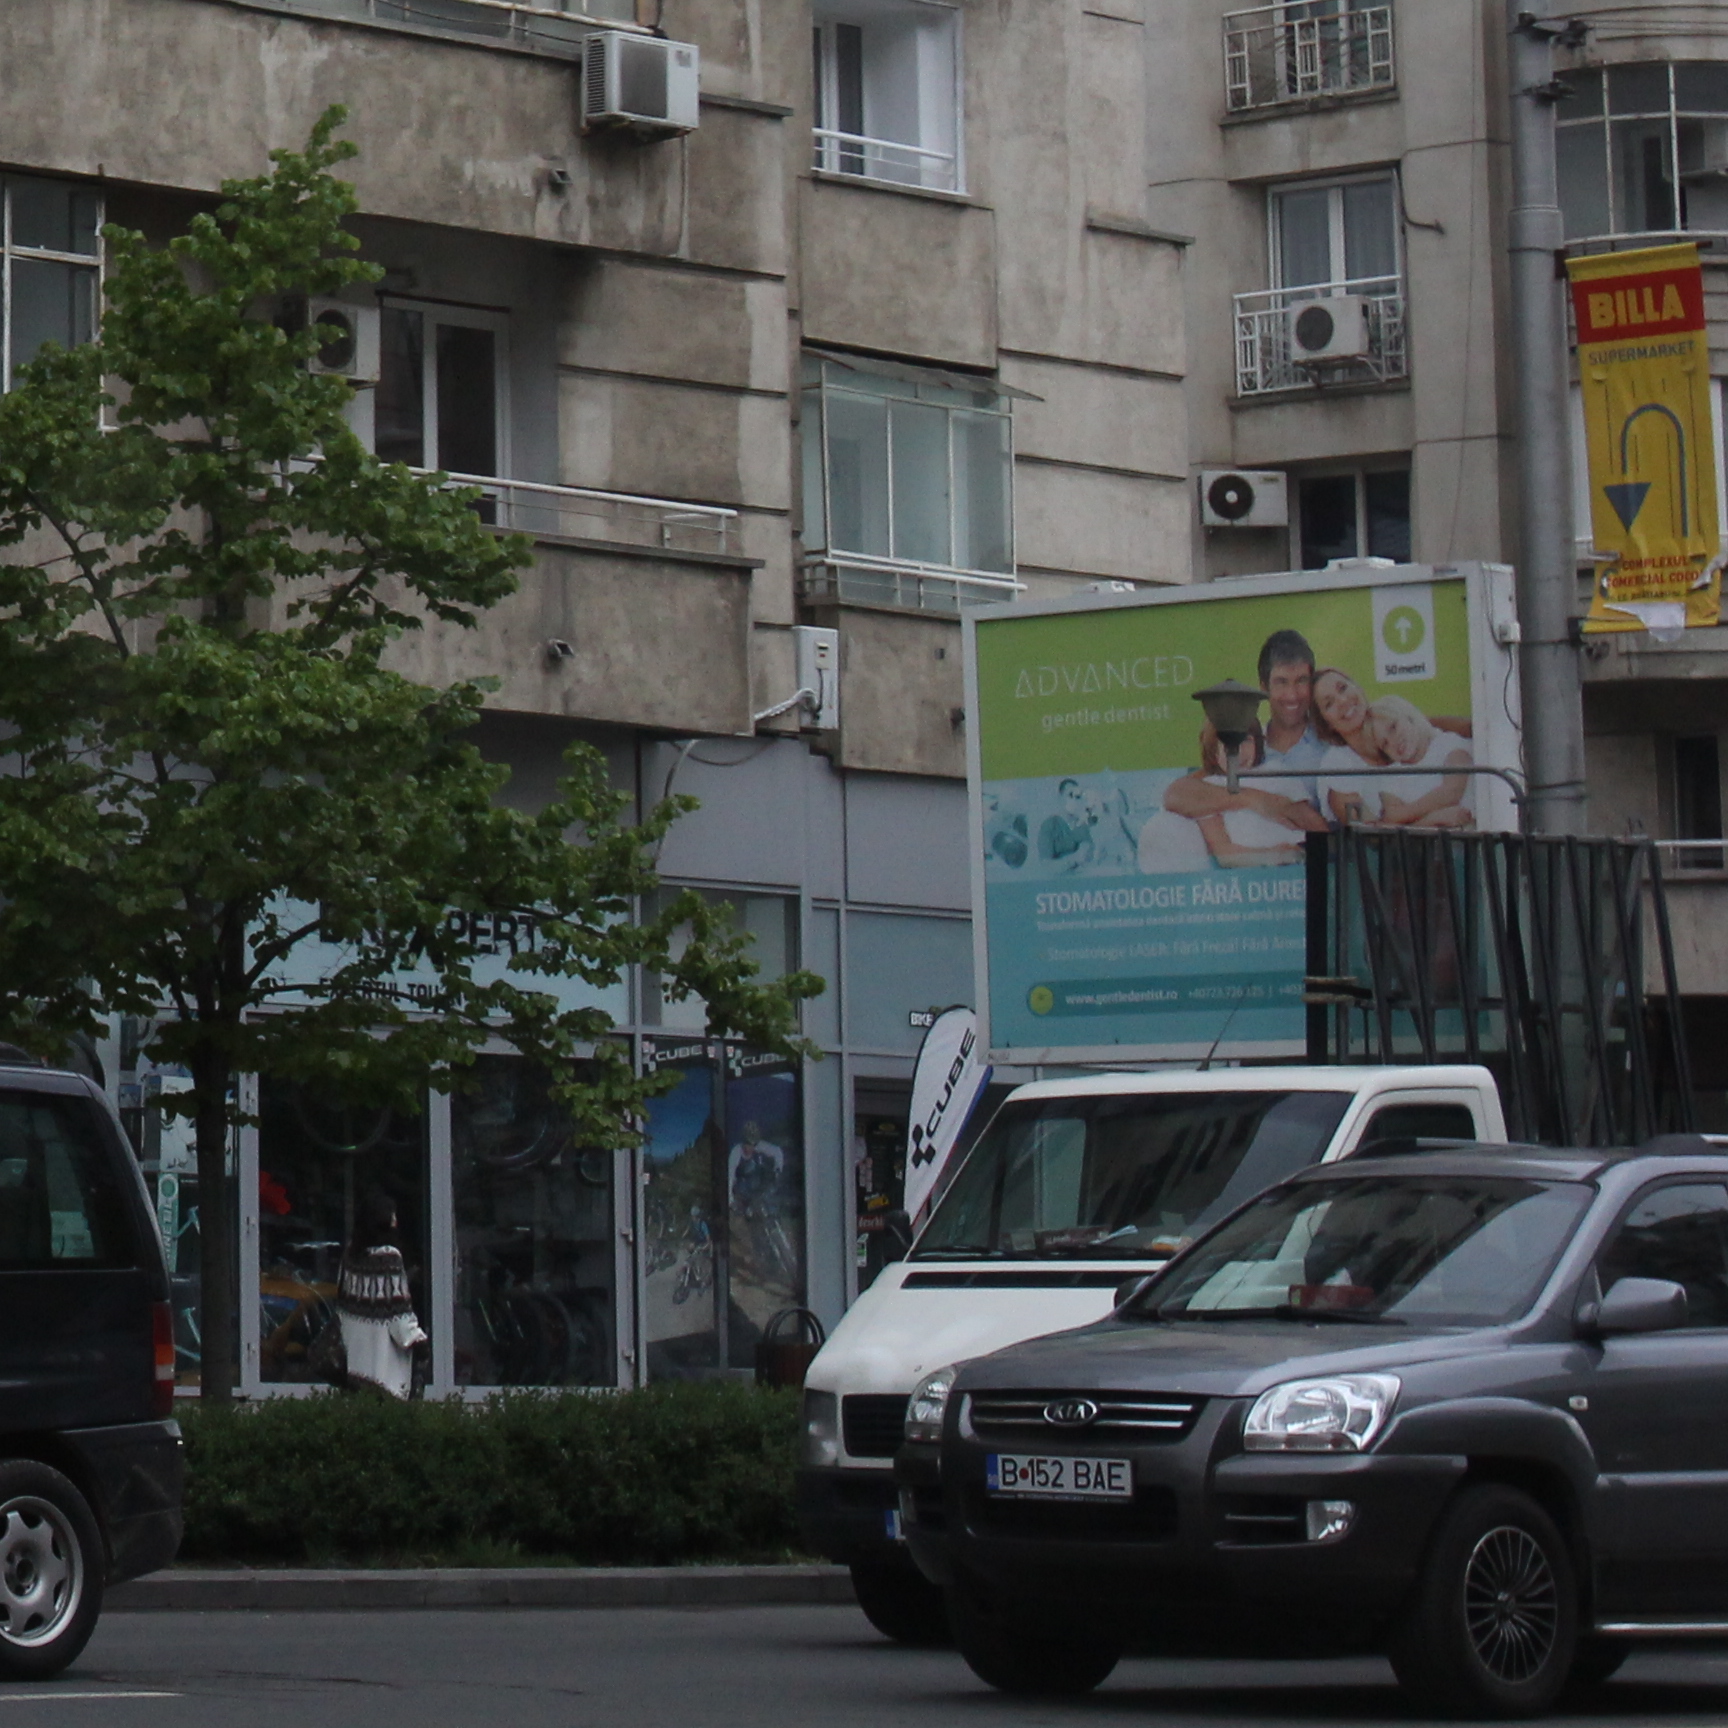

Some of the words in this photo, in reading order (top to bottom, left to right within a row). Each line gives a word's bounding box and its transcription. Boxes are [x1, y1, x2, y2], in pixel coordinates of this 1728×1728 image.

[1587, 283, 1685, 329] BILLA
[1588, 340, 1695, 365] SUPERMARKET
[1014, 654, 1194, 699] ADVANCED
[1384, 664, 1397, 675] 50
[1041, 706, 1101, 733] gentle
[1103, 703, 1171, 724] dentist
[1035, 885, 1186, 915] STOMATOLOGIE
[1191, 878, 1243, 905] FĂRĂ
[1065, 988, 1178, 1006] www.gentledentist.ro
[655, 1044, 704, 1062] CUBE
[926, 1027, 976, 1139] CUBE
[1053, 1403, 1087, 1420] KIA
[1001, 1458, 1018, 1486] B
[1027, 1458, 1064, 1488] 152
[1073, 1460, 1126, 1491] BAE
